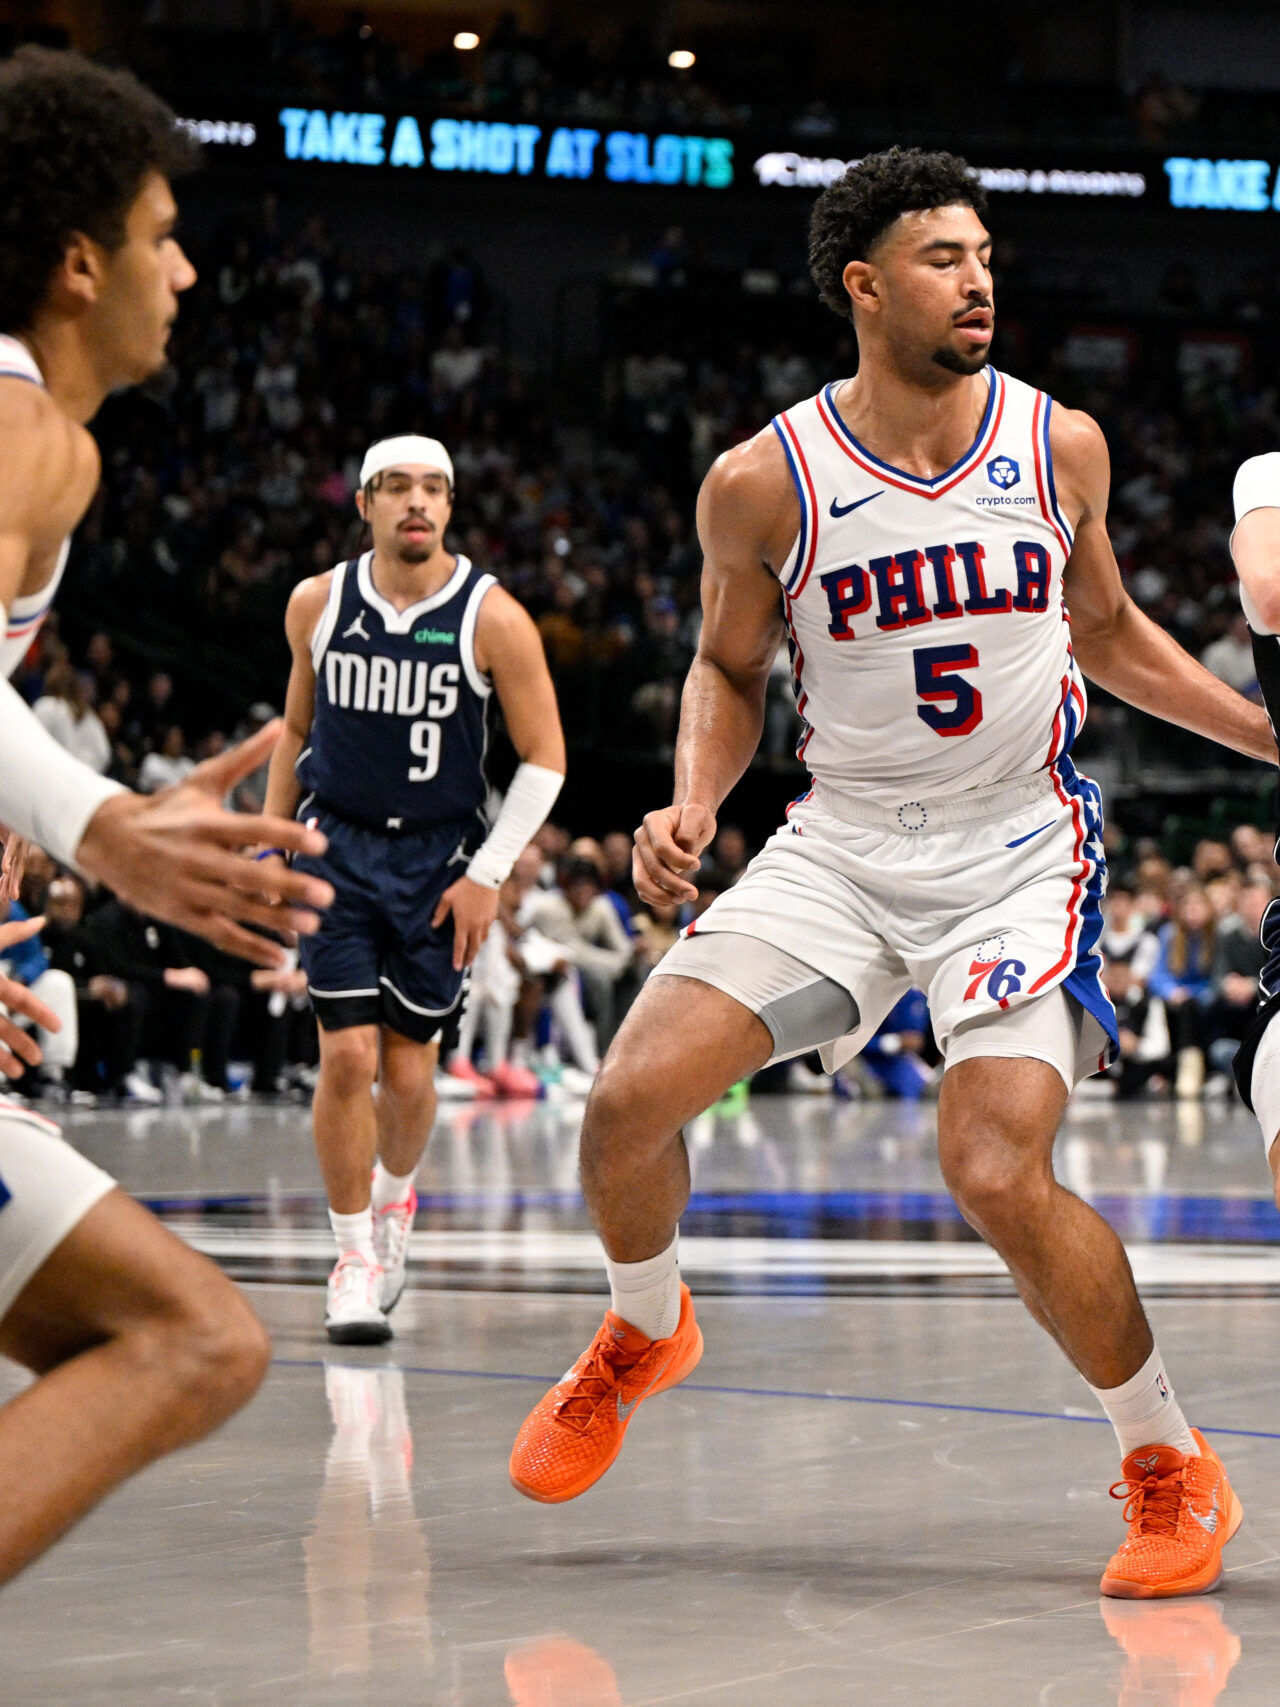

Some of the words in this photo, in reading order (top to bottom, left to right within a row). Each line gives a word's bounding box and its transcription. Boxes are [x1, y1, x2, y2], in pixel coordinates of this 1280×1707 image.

[278, 107, 386, 166] TAKE
[389, 115, 425, 168] A
[429, 118, 542, 176] SHOT
[545, 127, 600, 180] AT
[605, 130, 734, 188] SLOTS
[1163, 156, 1271, 212] TAKE
[976, 494, 1036, 507] crypto.com
[820, 541, 1051, 641] PHILA
[414, 628, 456, 645] chime
[326, 650, 460, 719] MAVS
[913, 643, 983, 737] 5
[408, 720, 442, 783] 9
[963, 956, 1026, 1003] 76
